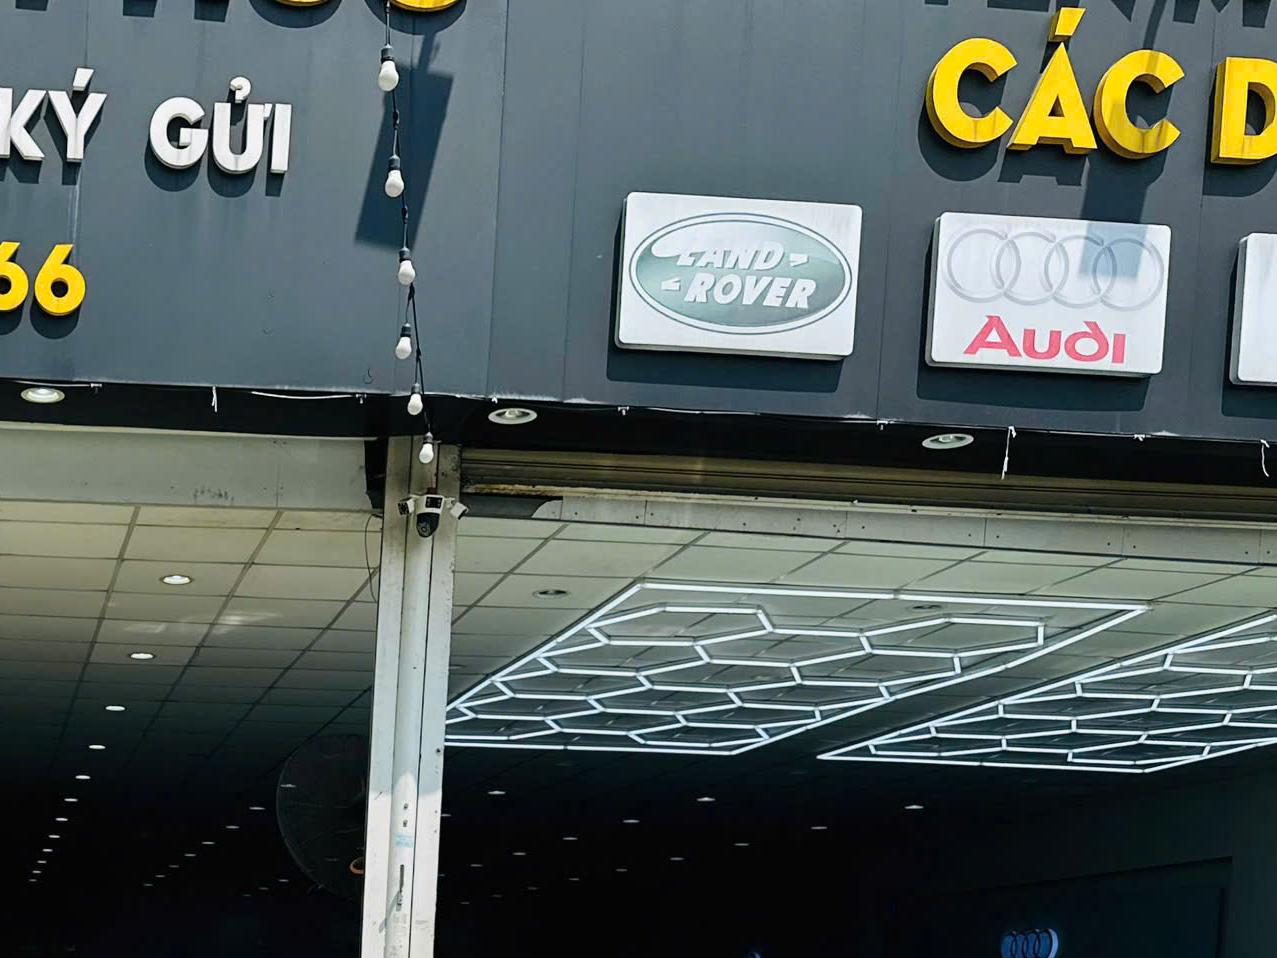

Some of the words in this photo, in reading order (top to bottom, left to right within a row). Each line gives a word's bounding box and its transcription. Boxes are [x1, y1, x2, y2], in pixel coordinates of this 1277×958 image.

[926, 7, 1184, 160] CÁC
[150, 76, 292, 174] GỬI
[676, 241, 784, 270] LAND
[684, 273, 816, 309] ROVER
[962, 313, 1127, 364] Audi
